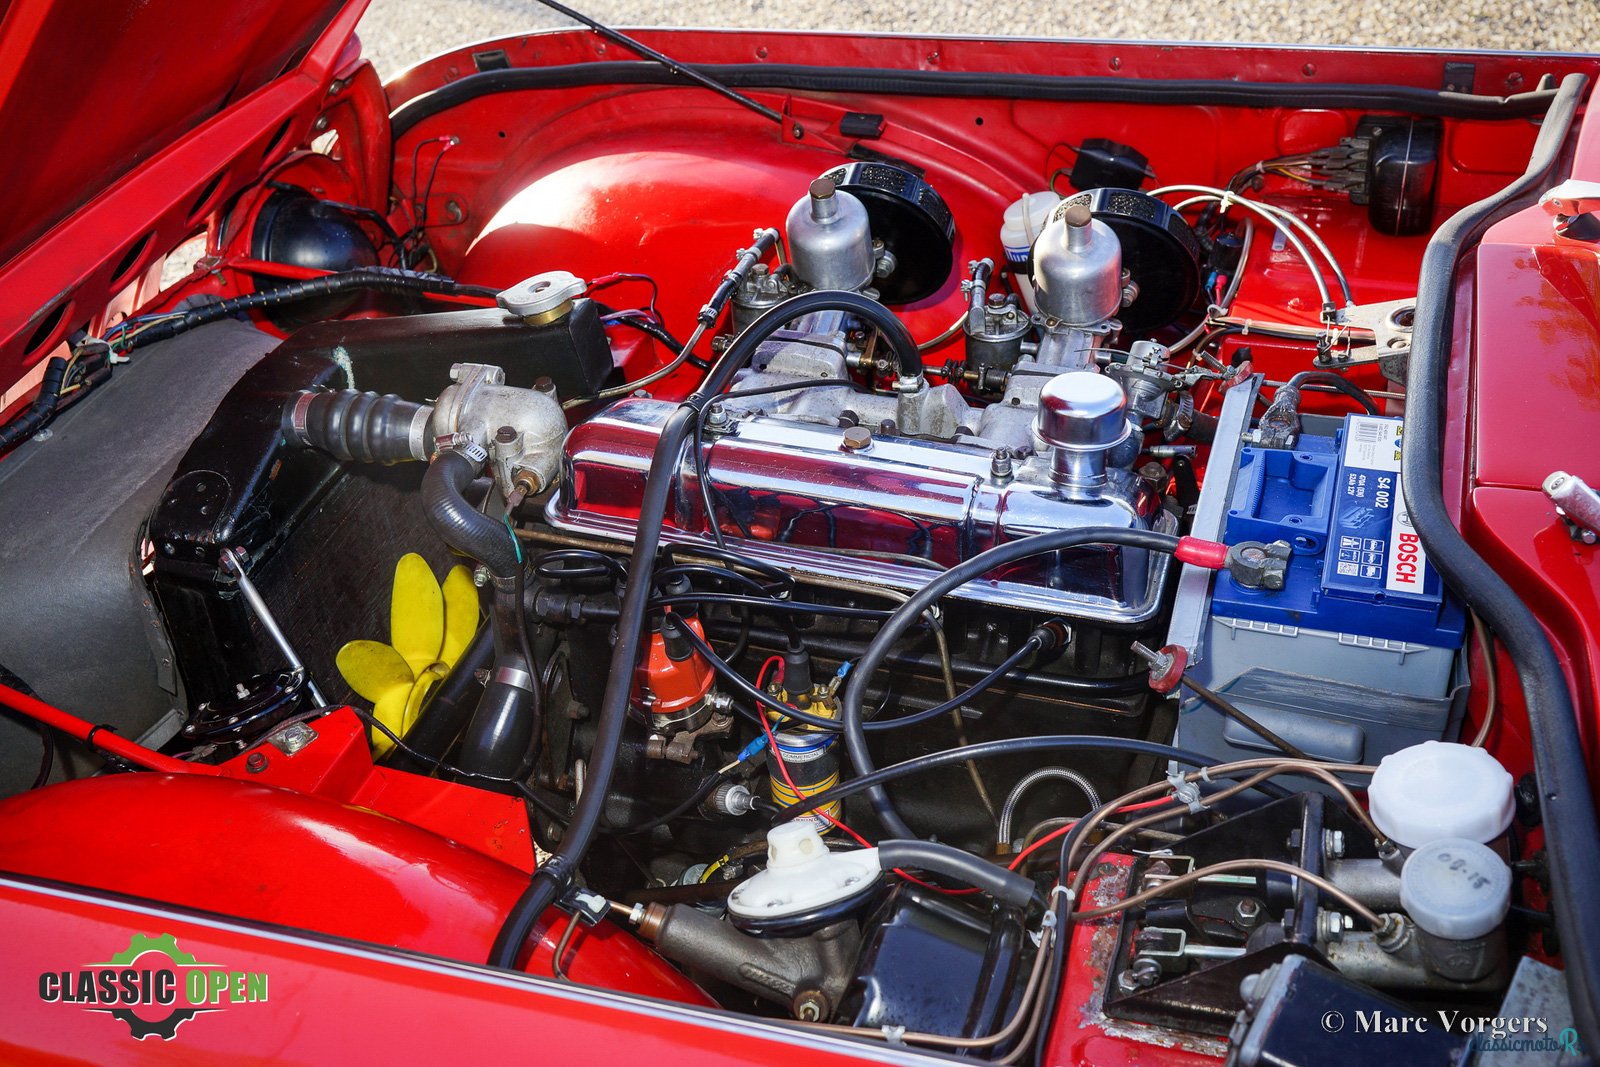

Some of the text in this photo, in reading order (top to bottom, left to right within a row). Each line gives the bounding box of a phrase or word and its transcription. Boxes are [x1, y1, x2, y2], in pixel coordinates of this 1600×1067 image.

[1375, 476, 1391, 509] S4 002
[1395, 532, 1419, 584] BOSCH
